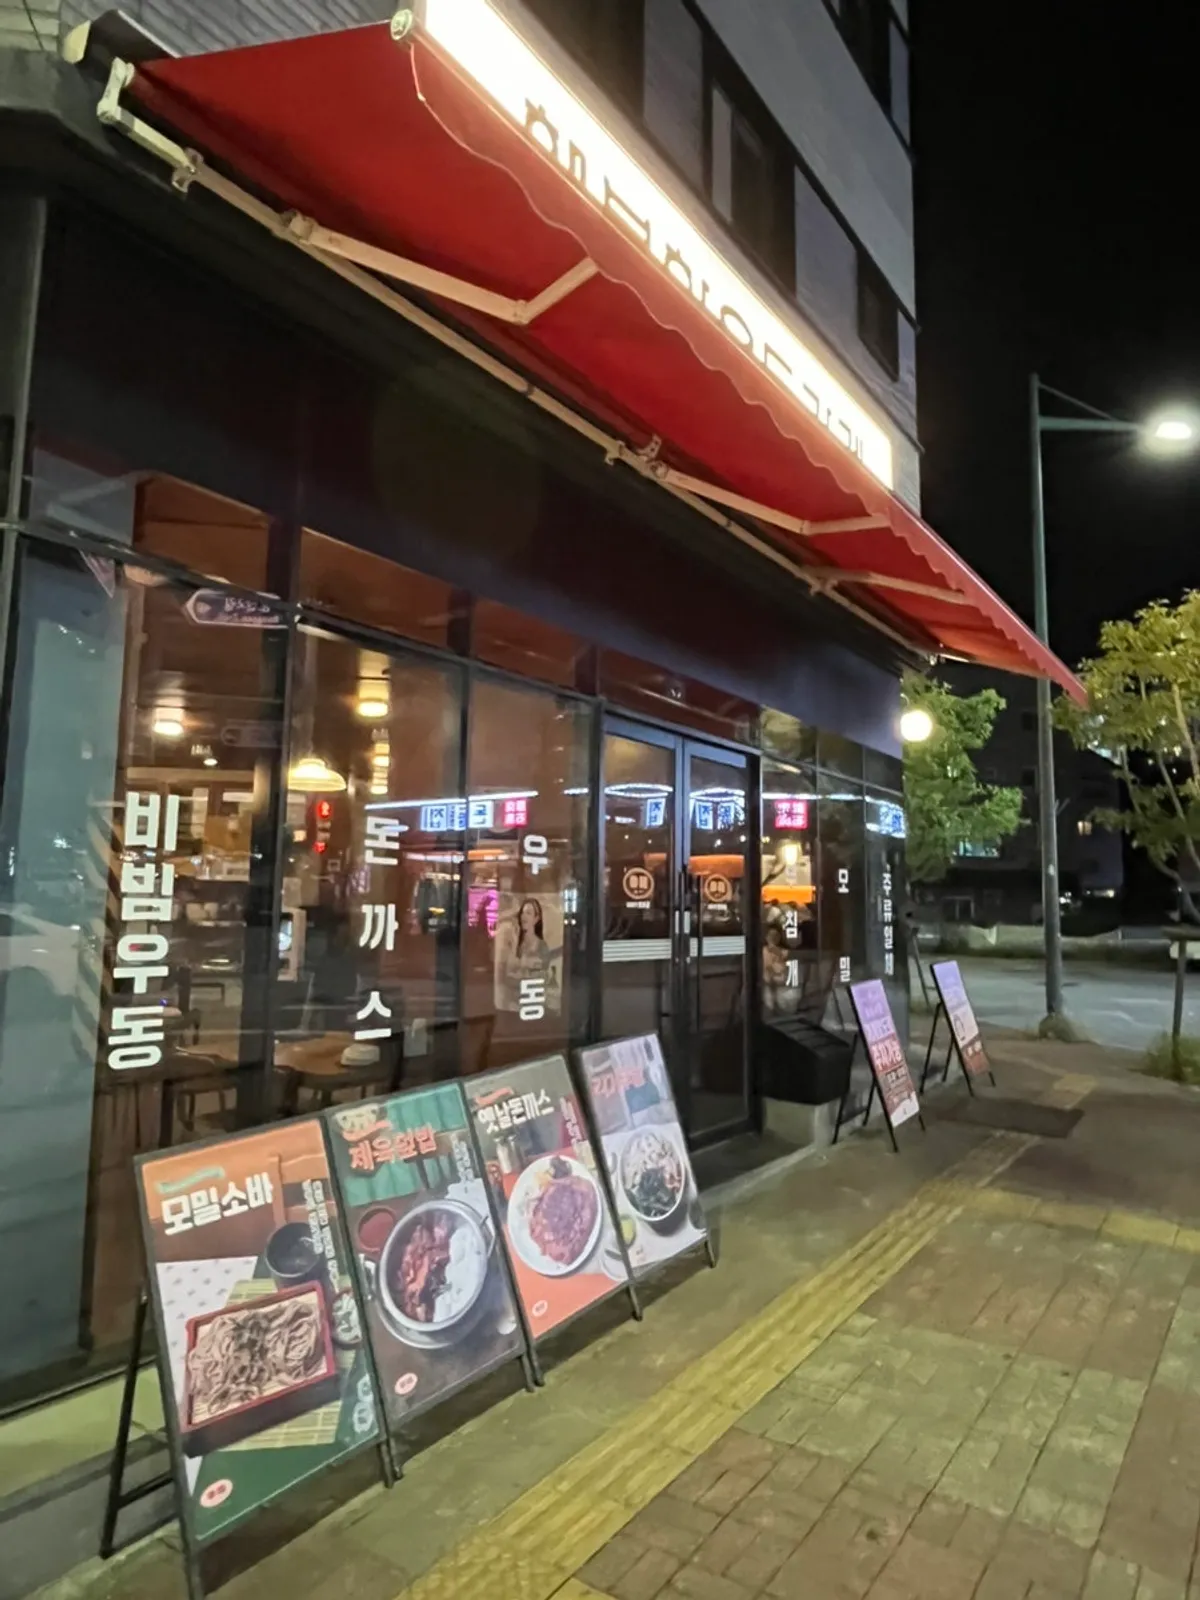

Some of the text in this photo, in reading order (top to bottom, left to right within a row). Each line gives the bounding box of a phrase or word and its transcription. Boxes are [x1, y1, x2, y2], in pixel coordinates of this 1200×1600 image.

[108, 791, 180, 1070] 비빔우동
[354, 816, 400, 1041] 돈까스
[519, 834, 548, 1021] 우동
[838, 868, 851, 983] 모밀
[477, 1088, 555, 1134] 옛날돈까스
[161, 1171, 274, 1236] 모밀소바
